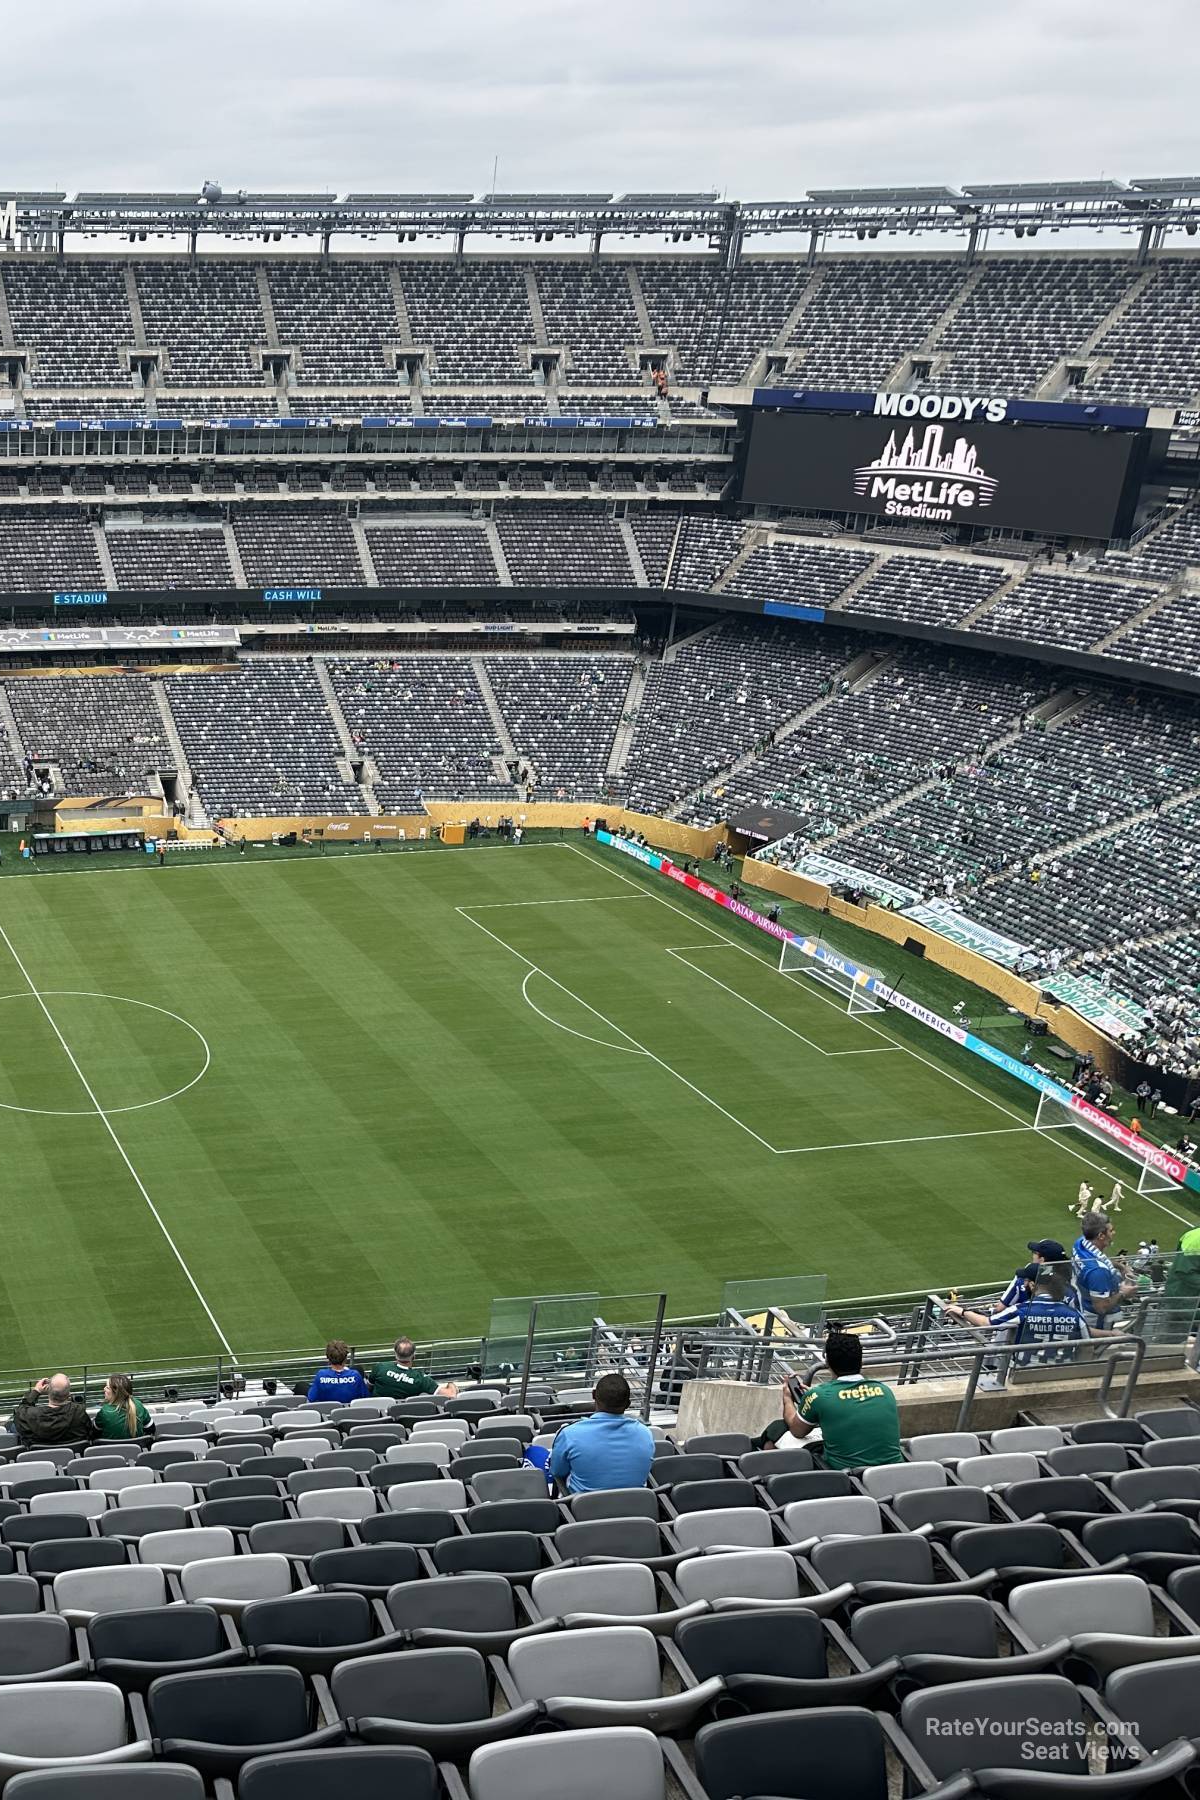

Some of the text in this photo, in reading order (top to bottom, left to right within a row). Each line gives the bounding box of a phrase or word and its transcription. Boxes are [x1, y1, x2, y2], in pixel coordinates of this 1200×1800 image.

[873, 393, 1008, 422] MOODY'S
[1180, 410, 1199, 418] Need
[870, 477, 975, 507] MetLife
[885, 500, 952, 520] Stadium
[265, 591, 293, 600] CASH
[610, 836, 650, 863] Hisense
[730, 899, 788, 939] QATAR AIRWAYS
[823, 952, 846, 972] VISA
[875, 984, 952, 1035] BANK OF AMERICA
[1008, 1061, 1036, 1083] ULTRA
[1074, 1097, 1123, 1141] Lenovo
[1128, 1134, 1181, 1178] Lenovo
[1027, 1316, 1076, 1324] SUPER BOCK
[1029, 1324, 1075, 1333] PAULO CRUZ
[386, 1370, 415, 1385] crefisa
[801, 1392, 818, 1416] crefisa
[838, 1385, 884, 1401] crefisa
